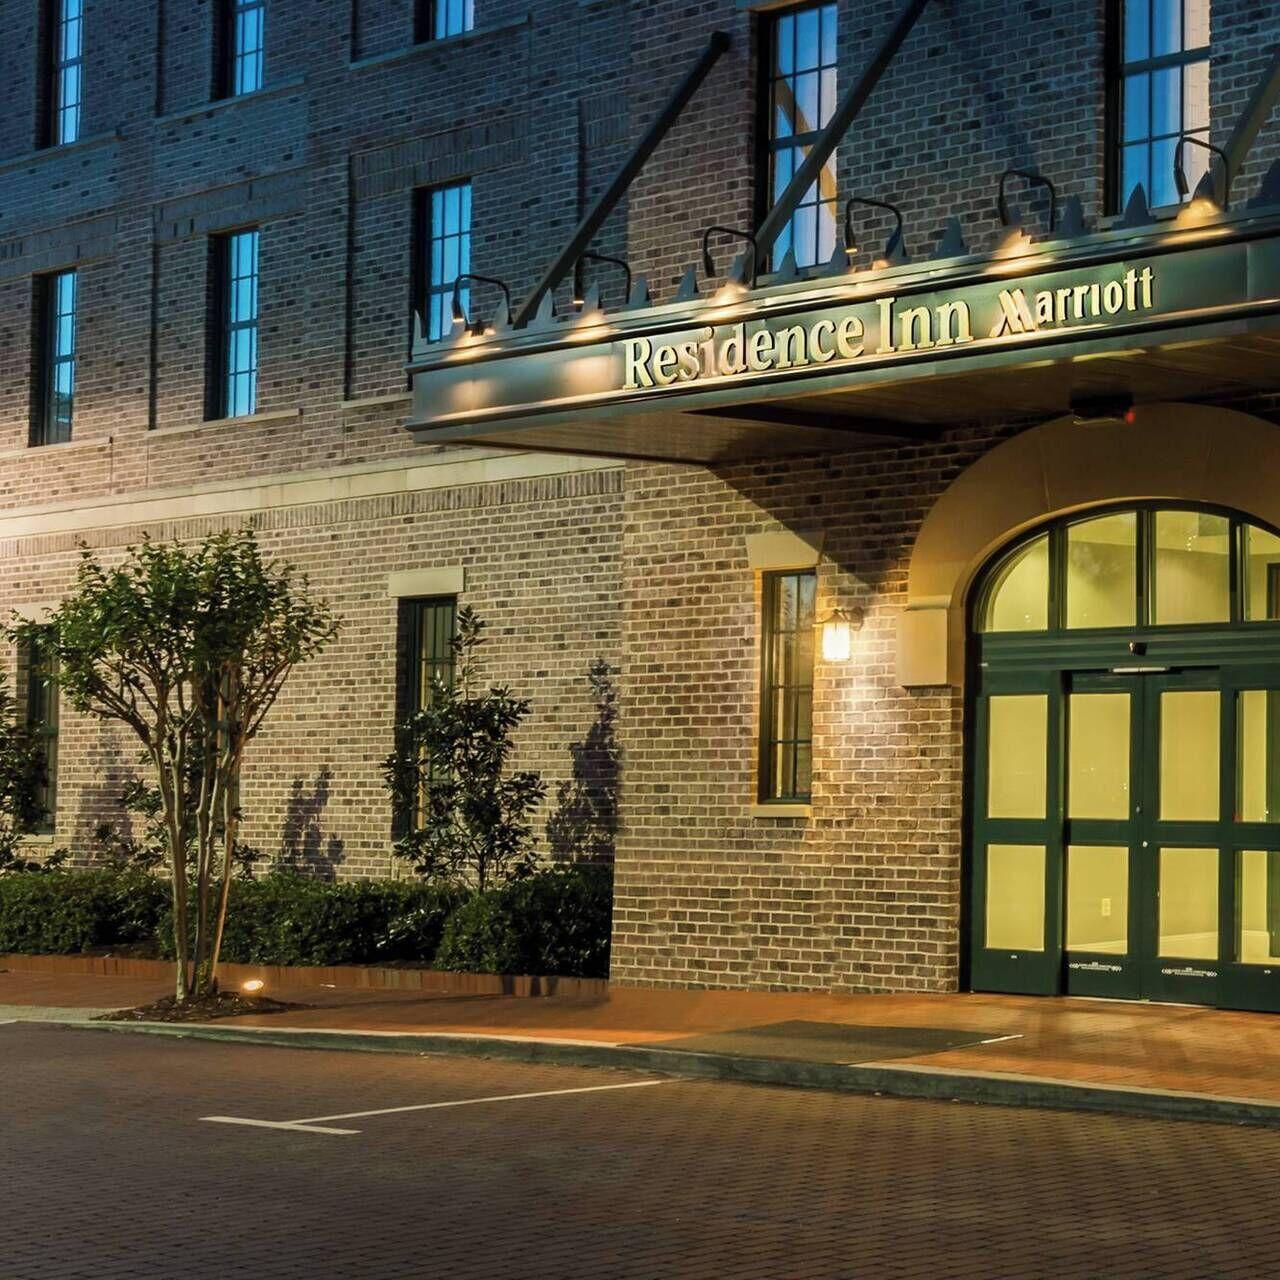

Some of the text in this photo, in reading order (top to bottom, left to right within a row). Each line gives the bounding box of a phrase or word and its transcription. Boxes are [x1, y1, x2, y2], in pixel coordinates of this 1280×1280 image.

[622, 266, 1156, 389] Residence Inn Marriott
